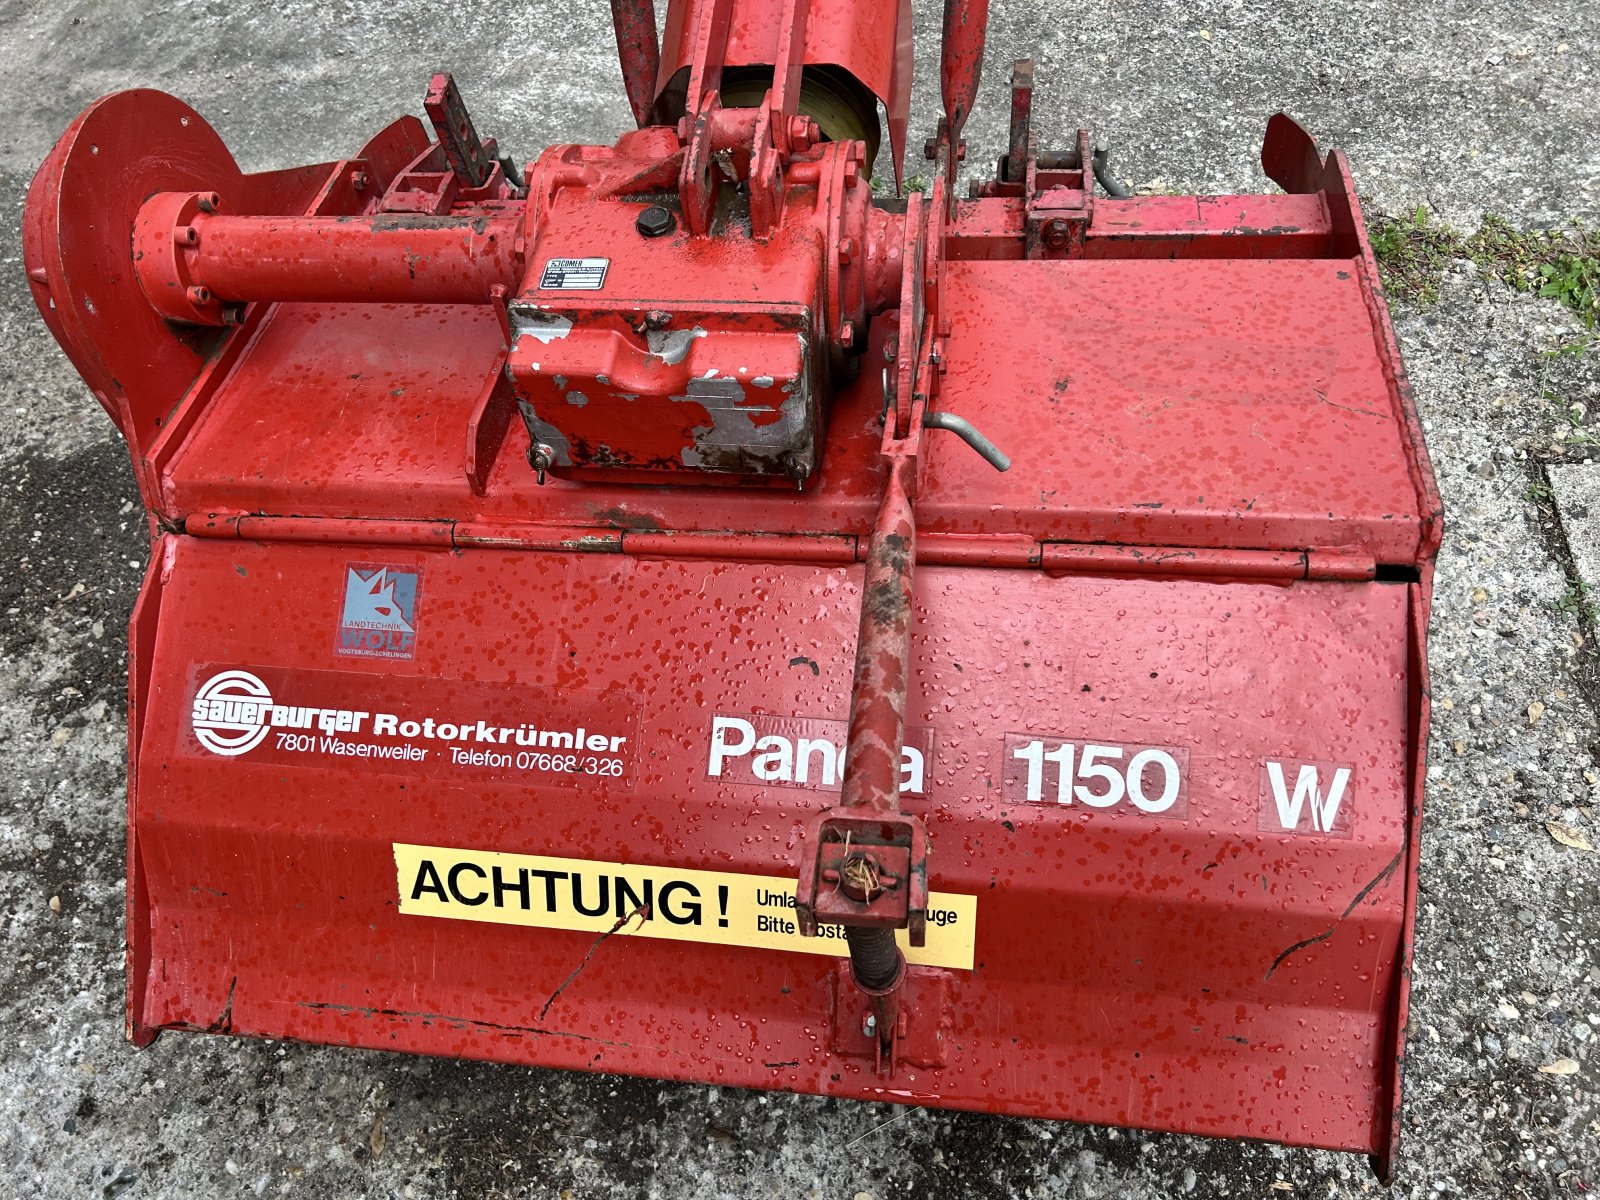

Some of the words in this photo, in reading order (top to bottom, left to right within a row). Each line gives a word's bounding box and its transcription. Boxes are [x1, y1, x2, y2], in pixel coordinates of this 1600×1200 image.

[341, 628, 415, 650] WOLF
[344, 620, 401, 630] LANDTECHNIK
[338, 648, 412, 659] VOGTSBURG-SCHELINGEN
[374, 713, 627, 753] Rotorkrümler
[275, 733, 315, 752] 7801
[320, 736, 429, 761] Wasenweiler
[449, 747, 512, 768] Telefon
[516, 751, 624, 777] 07668/326
[707, 716, 925, 794] Pana
[1013, 741, 1181, 813] 1150
[1266, 761, 1352, 833] W
[410, 860, 702, 926] ACHTUNG
[757, 915, 795, 934] Bitte
